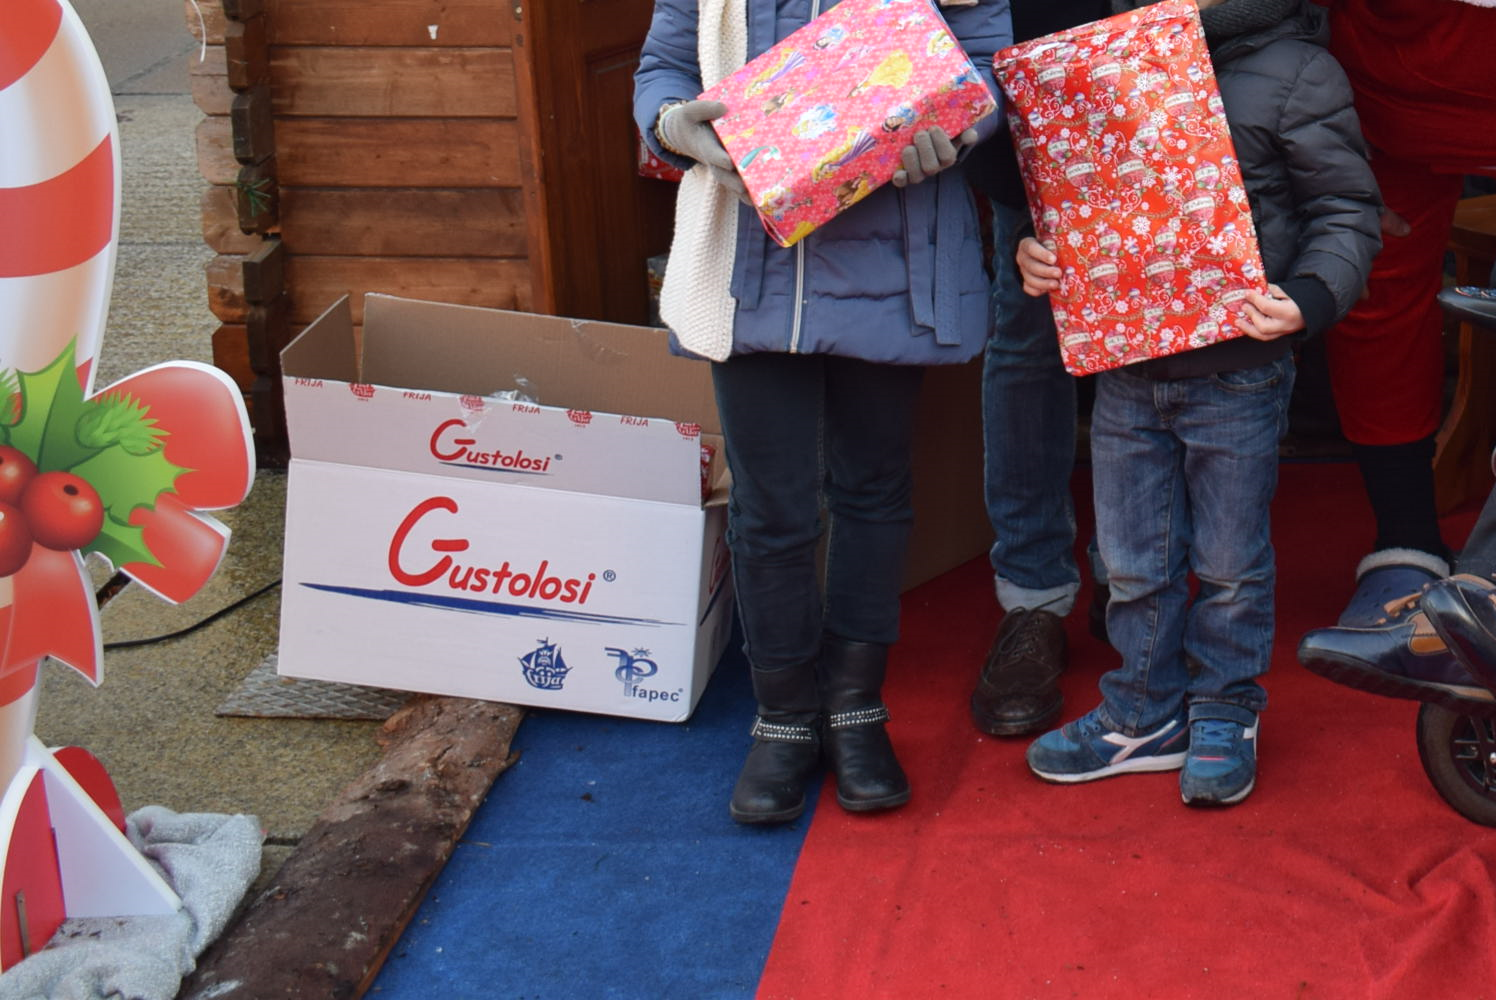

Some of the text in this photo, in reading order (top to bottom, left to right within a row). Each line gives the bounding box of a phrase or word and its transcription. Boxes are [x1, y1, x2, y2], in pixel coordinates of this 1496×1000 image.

[403, 391, 432, 402] FRIJA
[512, 403, 541, 415] FRIJA
[620, 415, 649, 427] FRIJA
[430, 418, 550, 472] Gustolosi
[388, 496, 596, 604] Gustolosi
[632, 685, 680, 702] fapec
